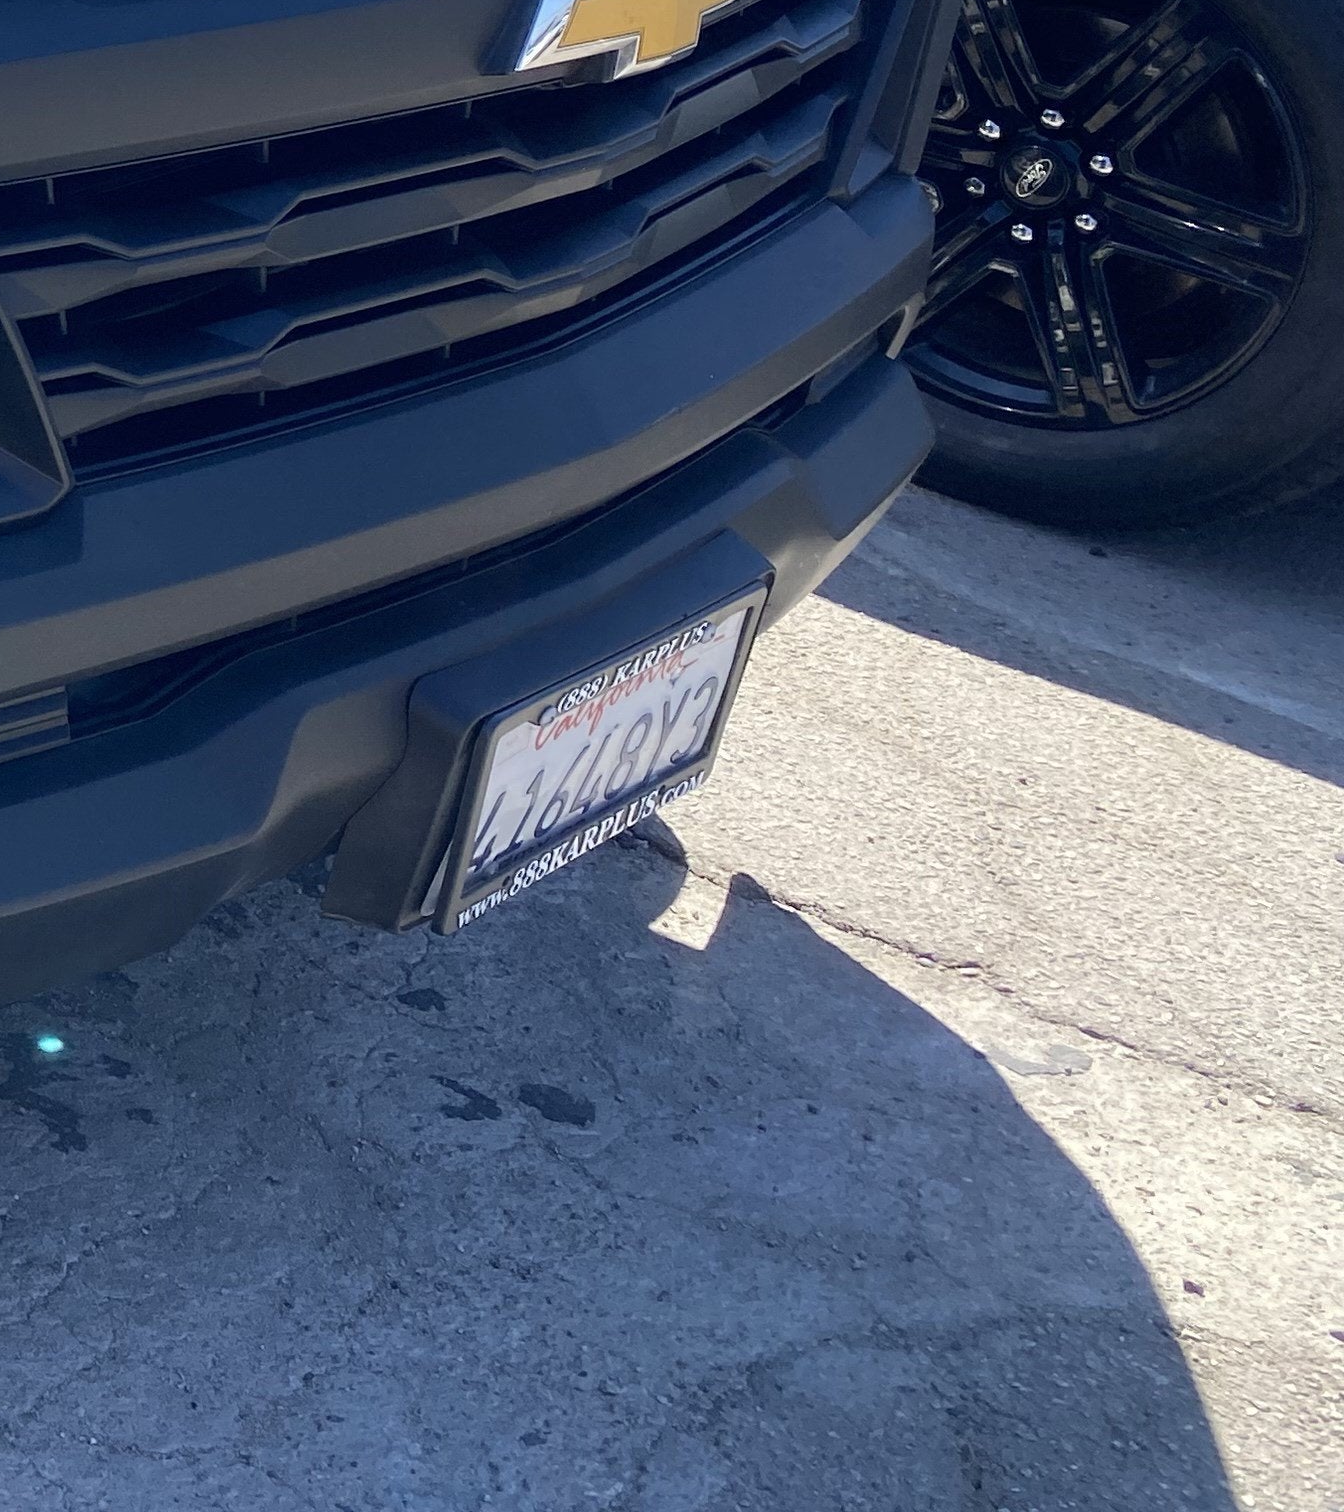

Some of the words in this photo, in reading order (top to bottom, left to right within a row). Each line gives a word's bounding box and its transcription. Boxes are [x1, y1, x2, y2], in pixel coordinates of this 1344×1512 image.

[1020, 163, 1047, 192] Ford
[557, 676, 608, 715] (888)
[611, 621, 709, 689] KARPLUS
[466, 676, 720, 874] 41648Y3
